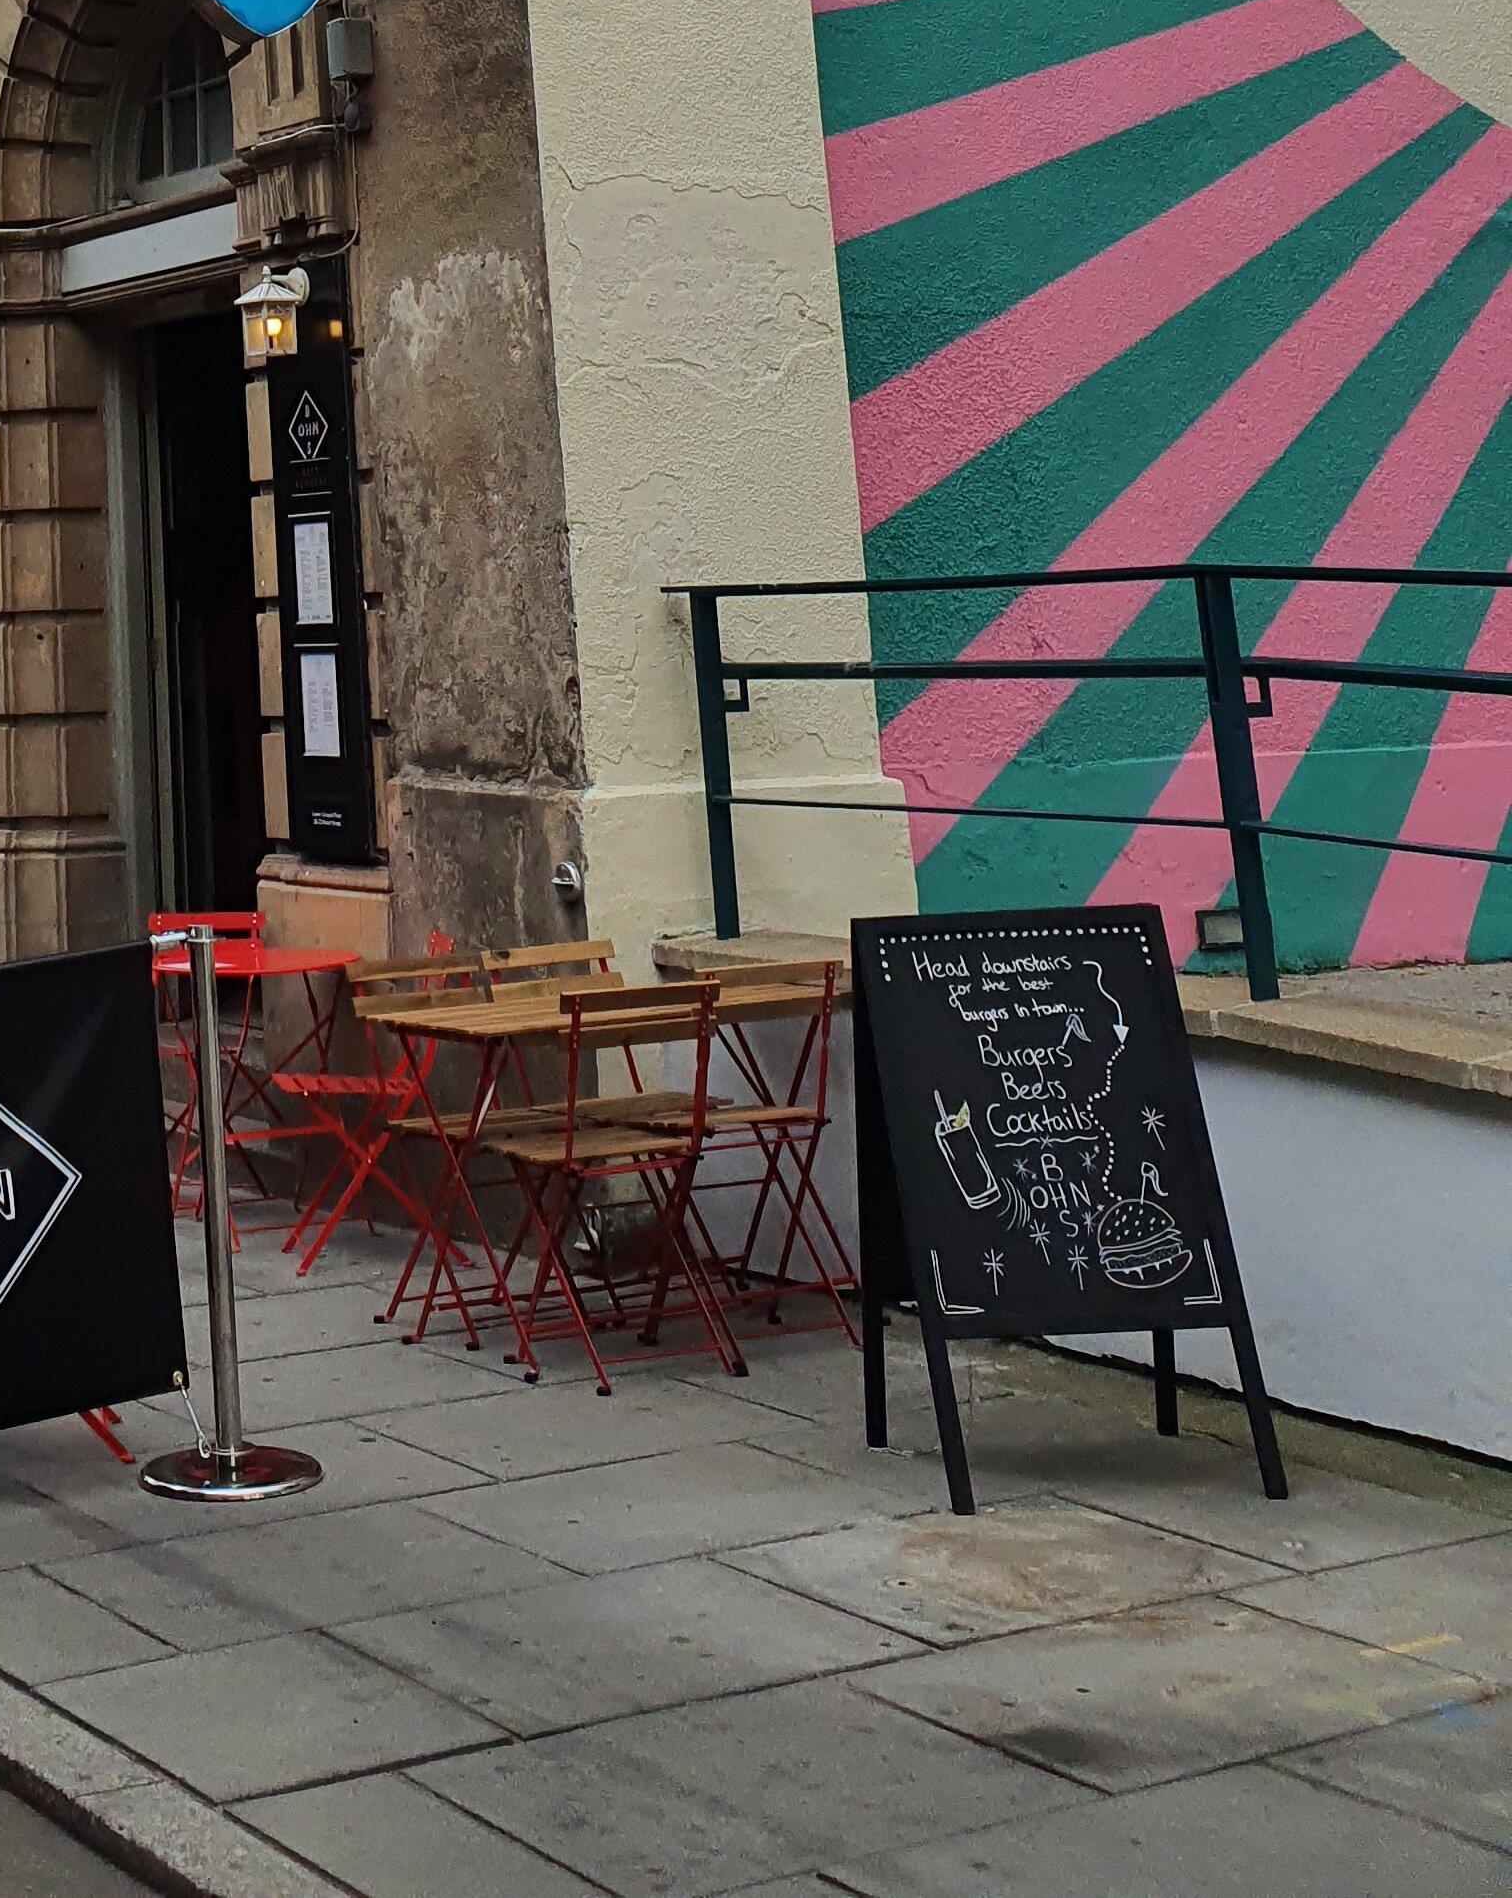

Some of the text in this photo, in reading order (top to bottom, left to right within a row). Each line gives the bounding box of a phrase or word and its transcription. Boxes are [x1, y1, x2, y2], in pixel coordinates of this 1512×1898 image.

[911, 951, 1072, 982] Head downstairs
[948, 975, 1054, 1008] for the best
[958, 1001, 1010, 1033] burgers
[977, 1034, 1073, 1083] Burgers
[1001, 1071, 1067, 1100] Beers
[986, 1102, 1093, 1137] Cocktails
[1029, 1180, 1092, 1210] OHN
